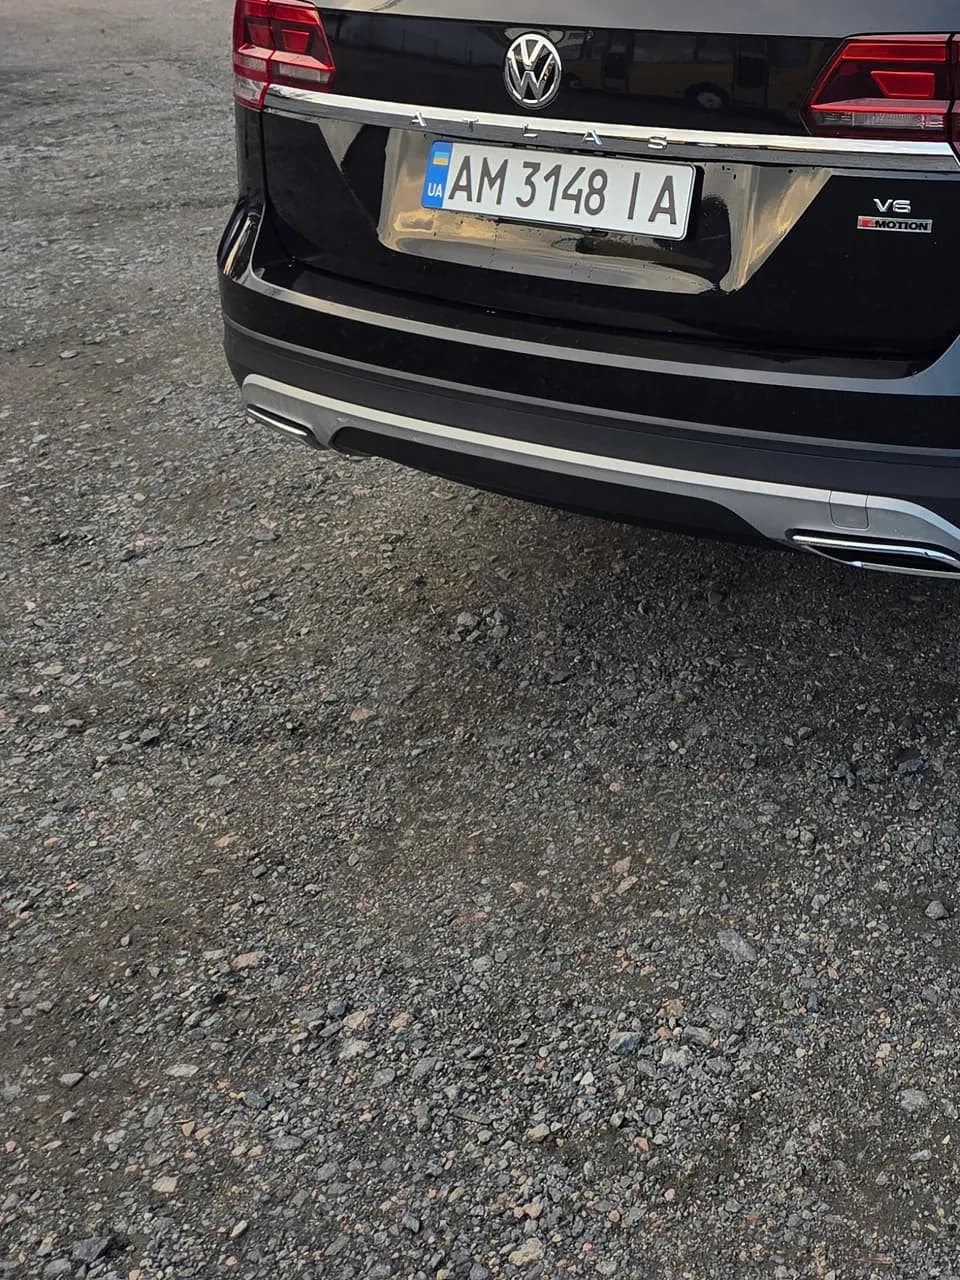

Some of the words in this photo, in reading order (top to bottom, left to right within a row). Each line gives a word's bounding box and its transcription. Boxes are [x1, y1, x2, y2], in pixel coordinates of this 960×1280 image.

[505, 33, 561, 108] VW
[411, 111, 668, 149] ATLAS
[427, 183, 443, 197] UA
[448, 155, 509, 205] AM
[515, 161, 608, 216] 3148
[627, 172, 677, 225] IA
[873, 198, 911, 213] V6
